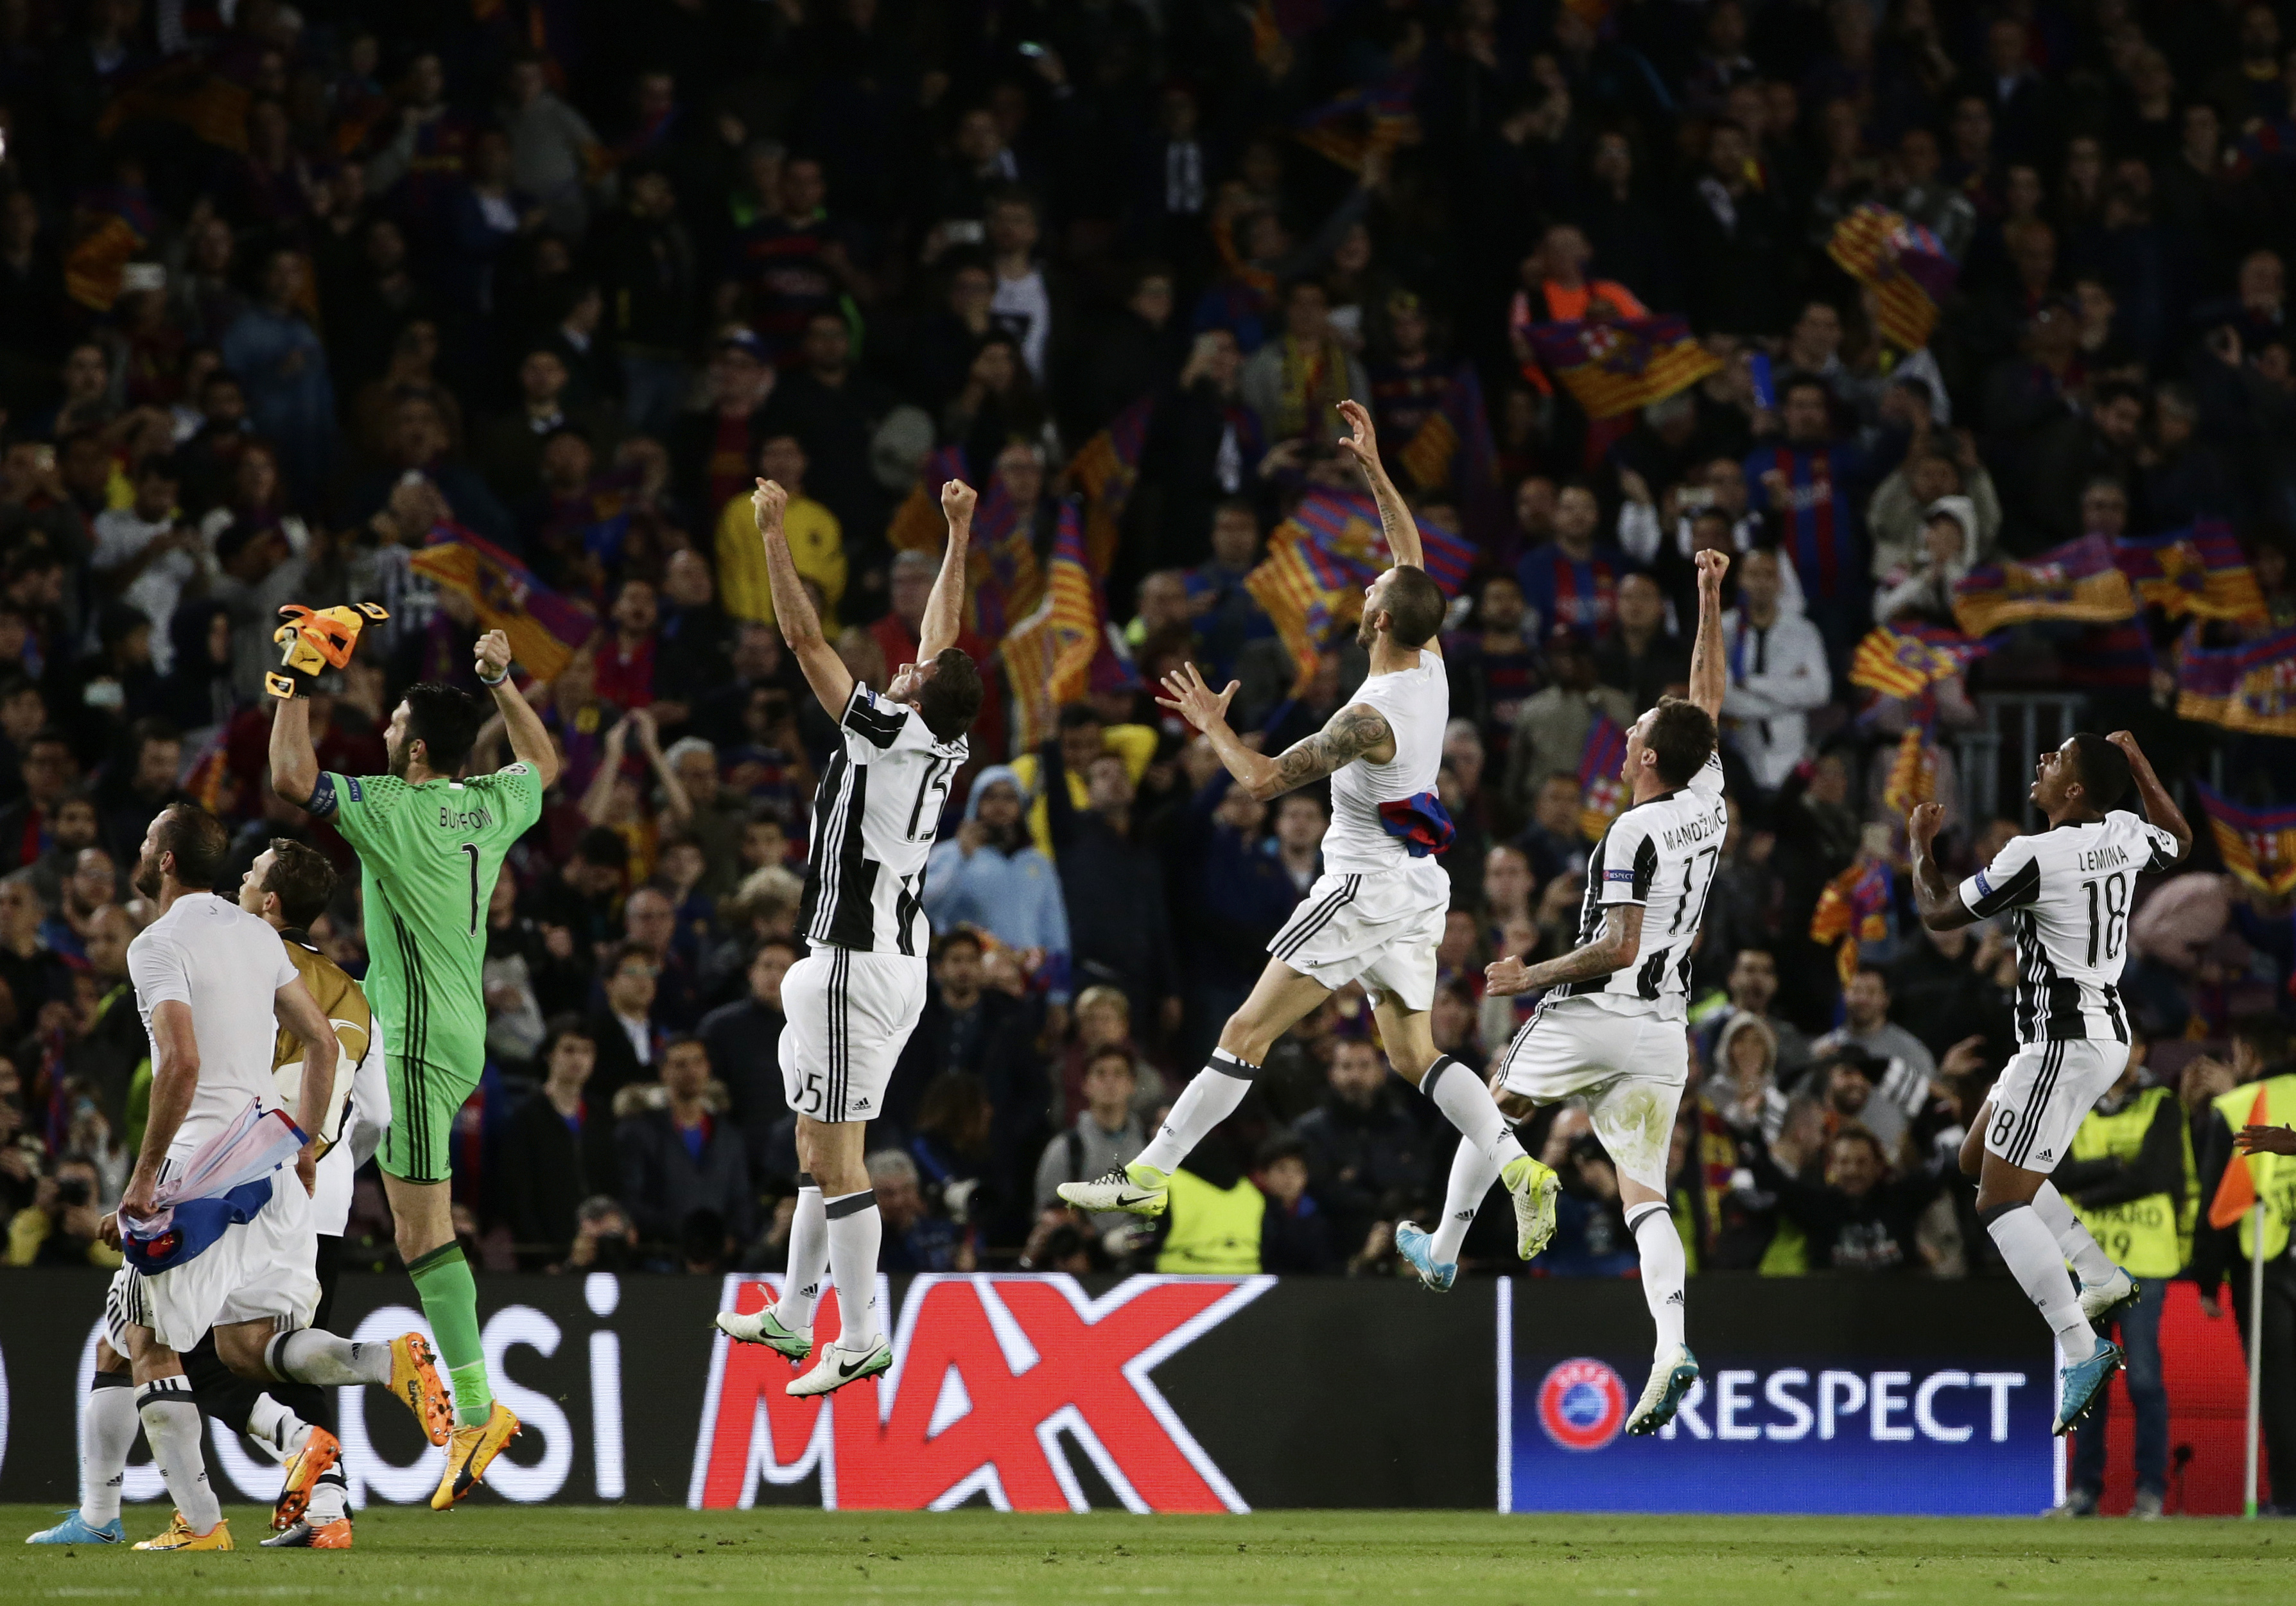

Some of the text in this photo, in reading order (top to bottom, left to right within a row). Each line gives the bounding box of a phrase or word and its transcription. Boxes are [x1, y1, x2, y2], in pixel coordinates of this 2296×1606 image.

[904, 752, 953, 843] 15
[460, 842, 480, 938] 1
[1667, 842, 1719, 938] 17
[2078, 844, 2129, 871] LEMINA
[2079, 870, 2127, 968] 18
[687, 1272, 1279, 1514] MAX
[1659, 1368, 2026, 1443] RESPECT
